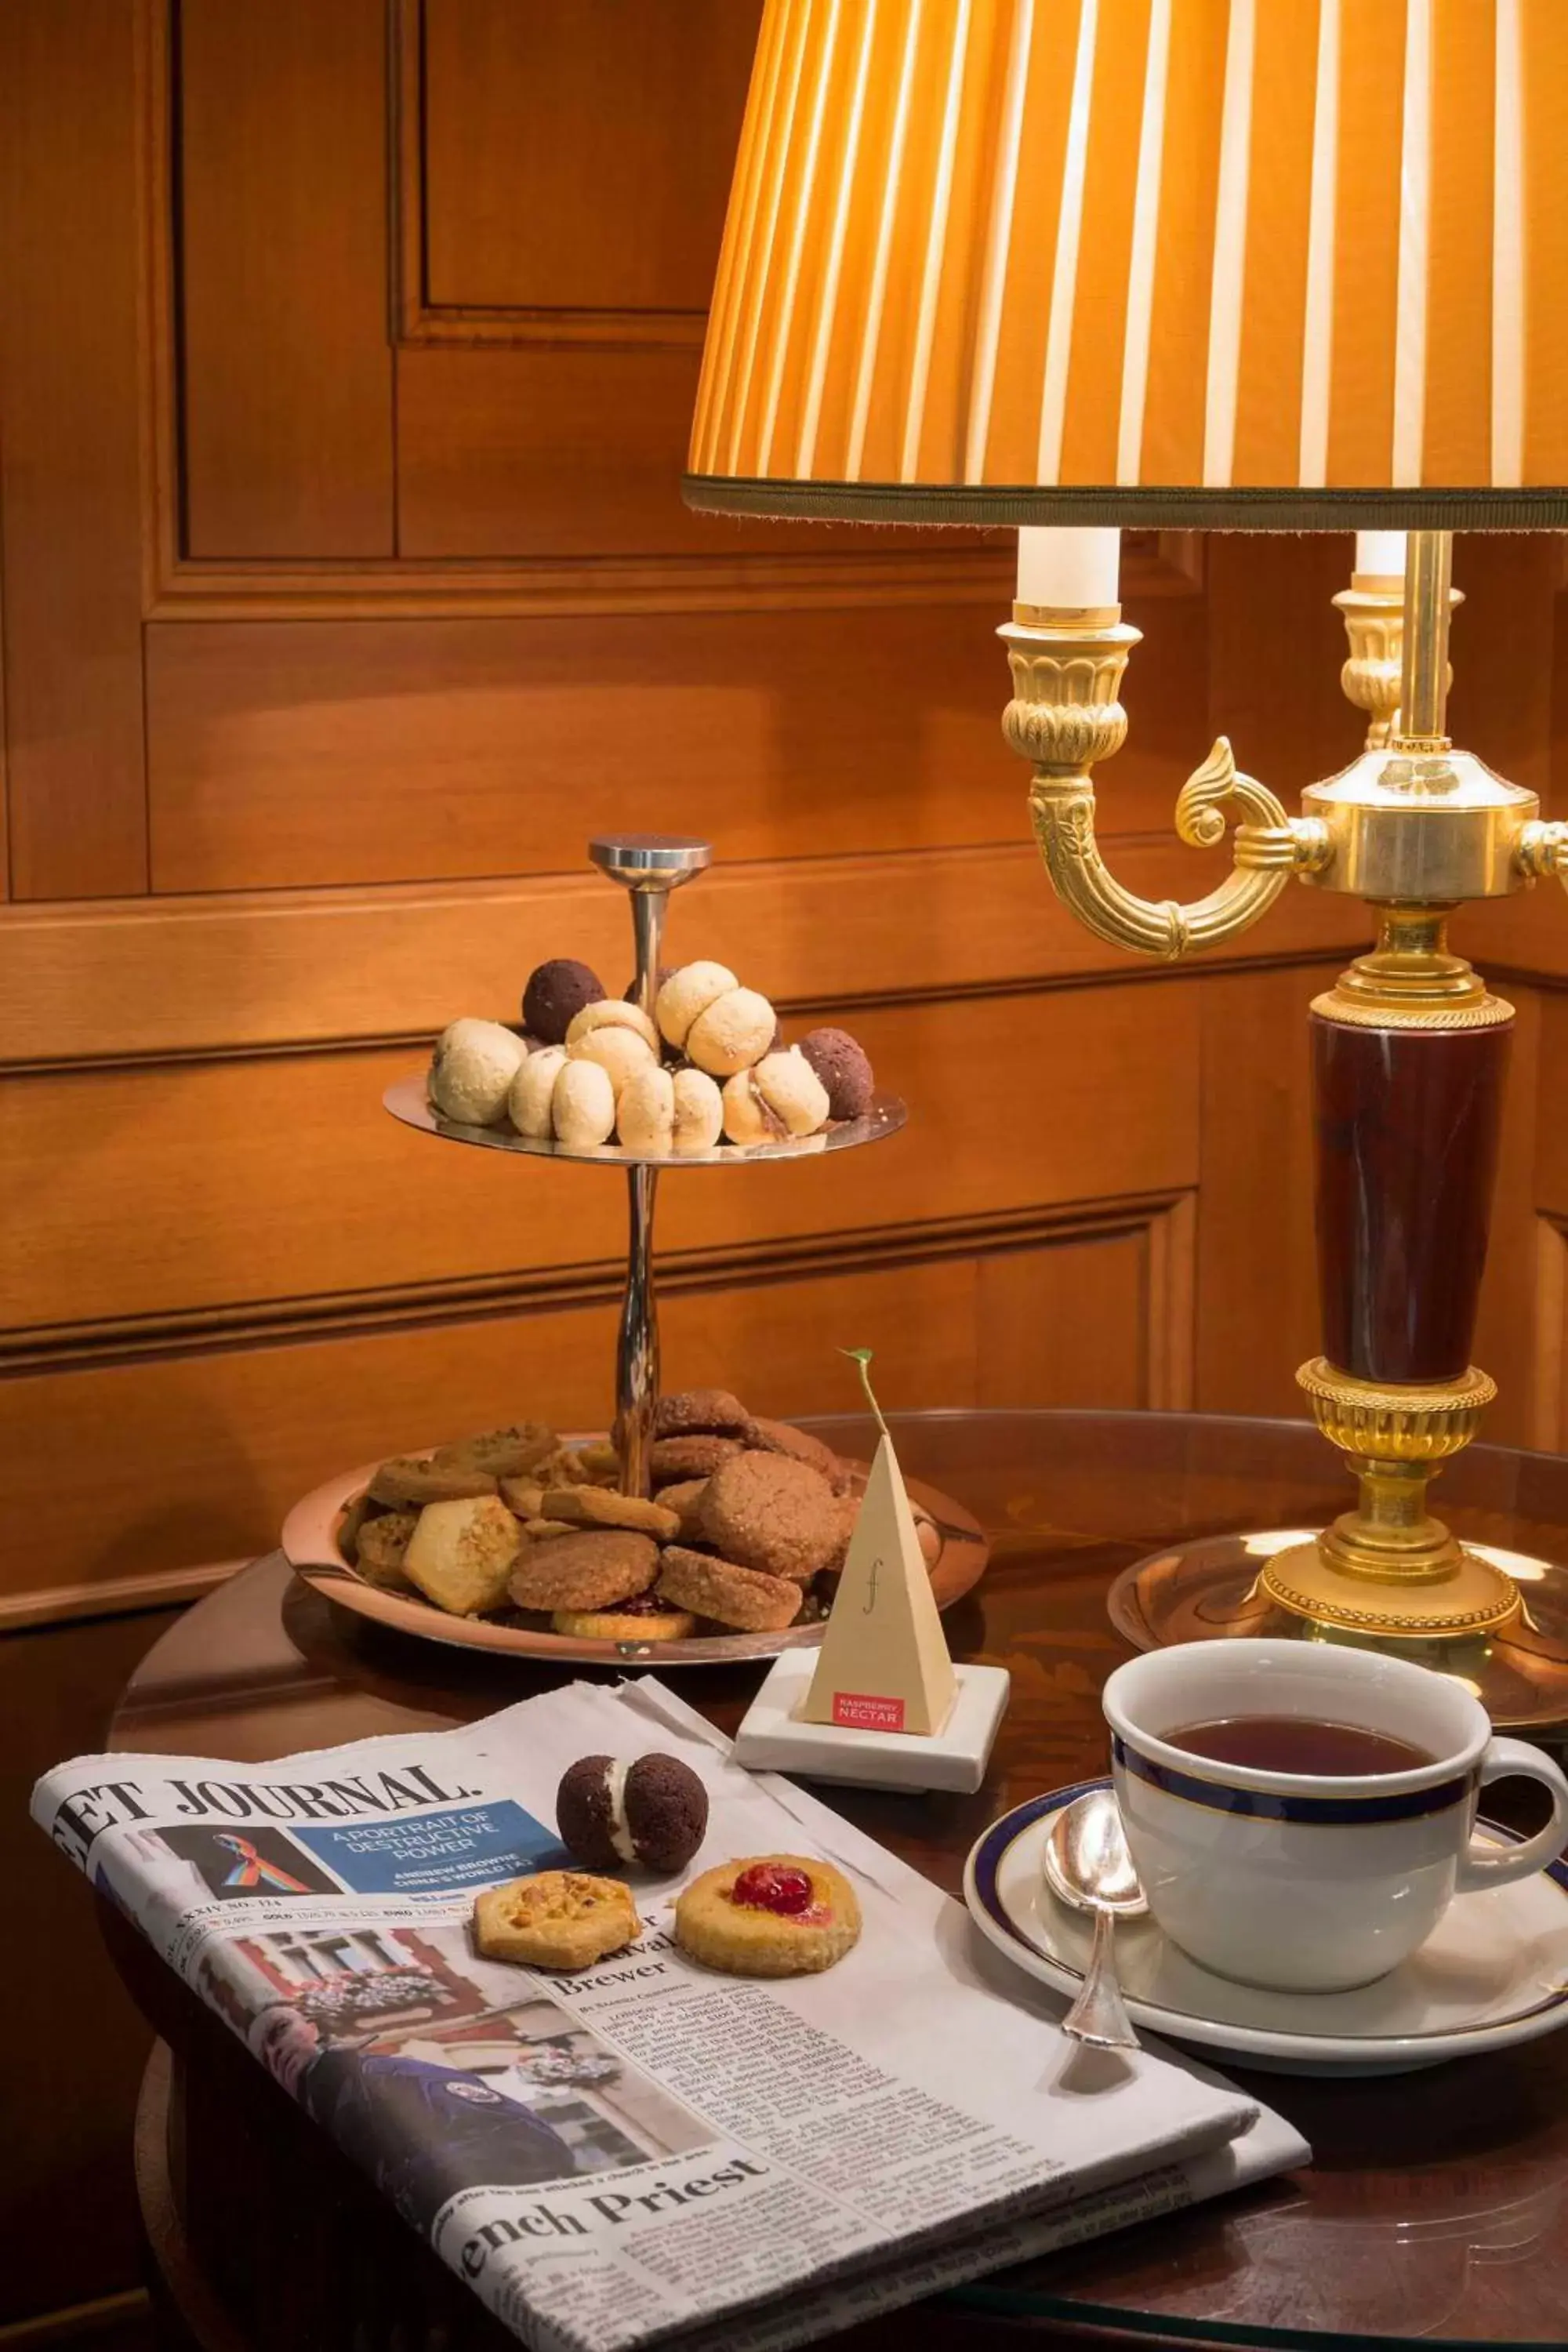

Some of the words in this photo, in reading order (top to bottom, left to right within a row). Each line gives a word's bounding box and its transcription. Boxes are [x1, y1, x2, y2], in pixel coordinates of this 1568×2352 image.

[839, 1708, 897, 1723] NECTAR
[840, 1698, 898, 1711] RASPBERRY
[52, 1781, 157, 1874] ET
[163, 1765, 484, 1818] JOURNAL.
[333, 1831, 348, 1842] A
[350, 1814, 461, 1840] PORTRAIT
[462, 1810, 489, 1824] OF
[345, 1822, 501, 1853] DESTRUCTIVE
[393, 1838, 477, 1860] POWER
[551, 1961, 668, 1996] Brewer
[459, 2204, 591, 2281] ench
[583, 2159, 770, 2224] Priest
